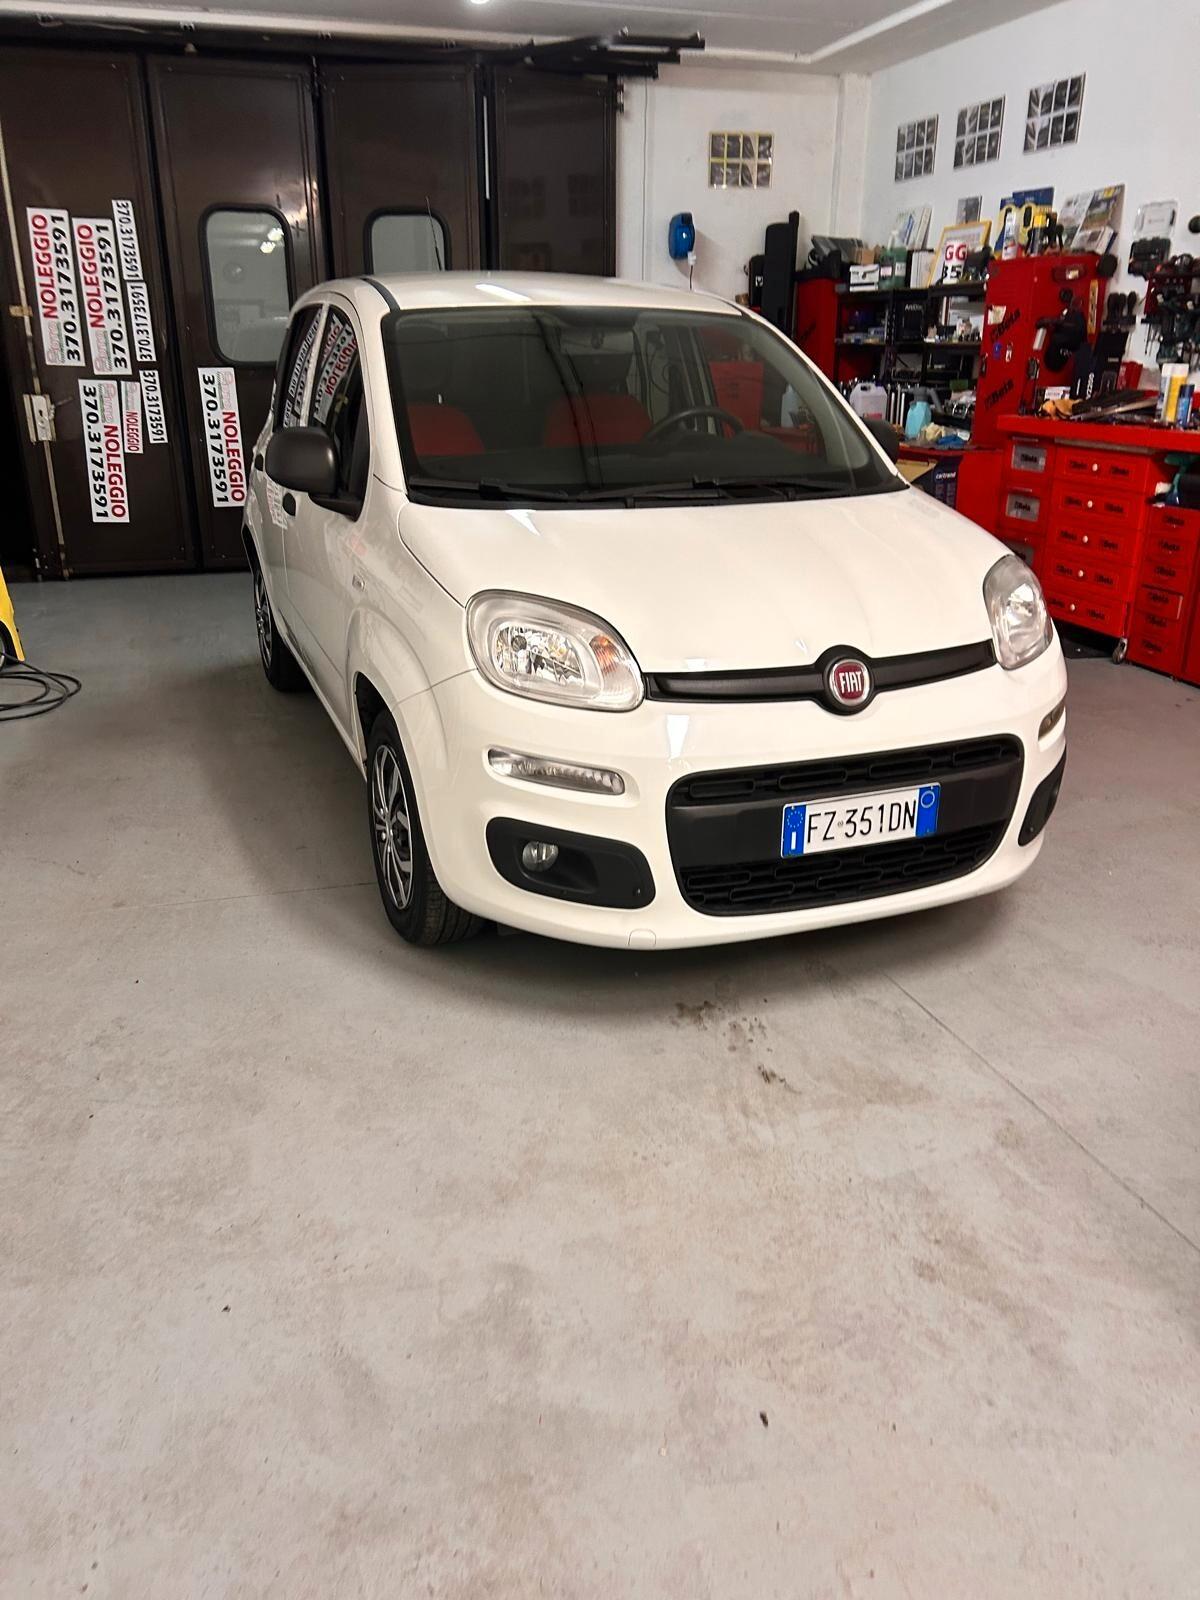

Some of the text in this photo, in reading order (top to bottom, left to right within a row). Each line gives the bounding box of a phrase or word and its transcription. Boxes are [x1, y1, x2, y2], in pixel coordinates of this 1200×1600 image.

[31, 214, 59, 319] NOLEGGIO
[77, 224, 106, 328] NOLEGGIO
[116, 201, 139, 279] 370.3173591
[51, 215, 81, 362] 370.3173591
[96, 224, 128, 369] 370.3173591
[134, 285, 153, 361] 370.3173591
[83, 386, 108, 519] 370.3173591
[125, 411, 140, 452] NOLEGGIO
[143, 371, 164, 443] 370.3173591
[203, 374, 228, 504] 370.3173591
[103, 424, 126, 518] NOLEGGIO
[223, 411, 245, 502] NOLEGGIO
[838, 670, 863, 694] FIAT
[807, 799, 917, 843] FZ 351DN
